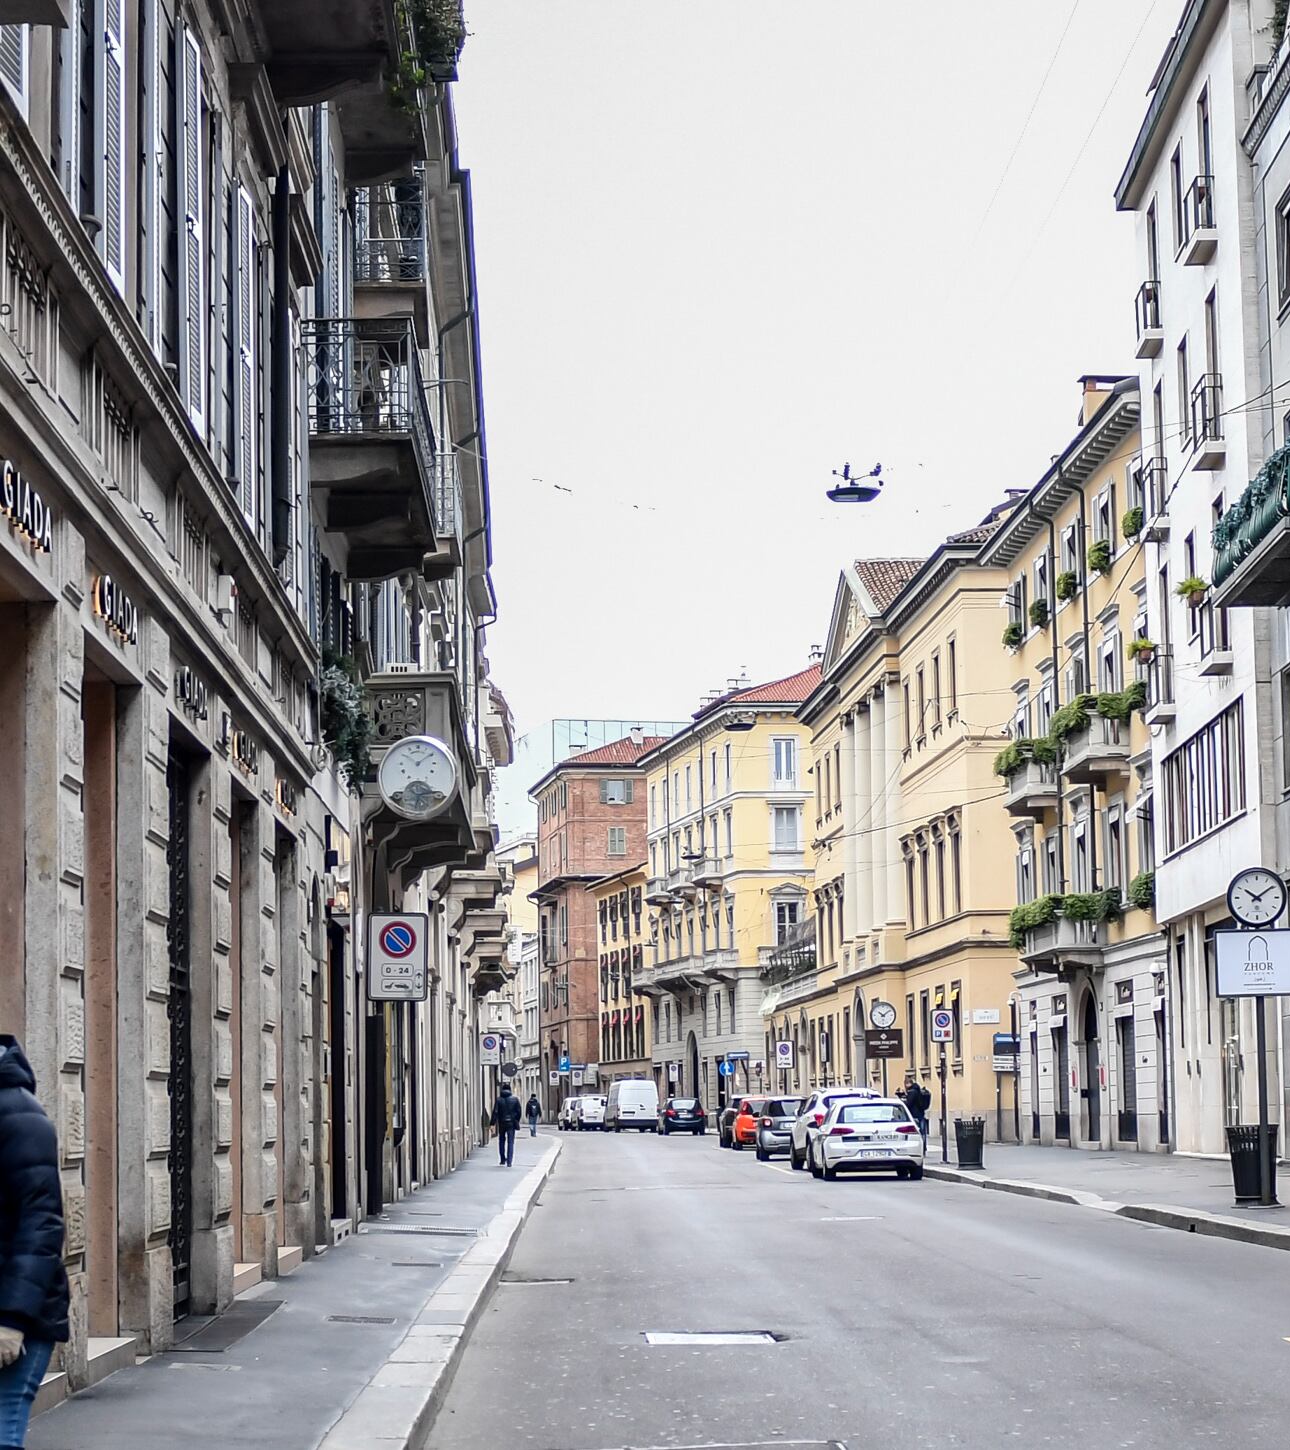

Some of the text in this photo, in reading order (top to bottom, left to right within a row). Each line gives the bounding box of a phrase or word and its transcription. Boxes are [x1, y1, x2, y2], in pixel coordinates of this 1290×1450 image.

[2, 459, 53, 553] GIADA
[101, 574, 139, 646] GIADA
[1244, 961, 1274, 972] ZHOR
